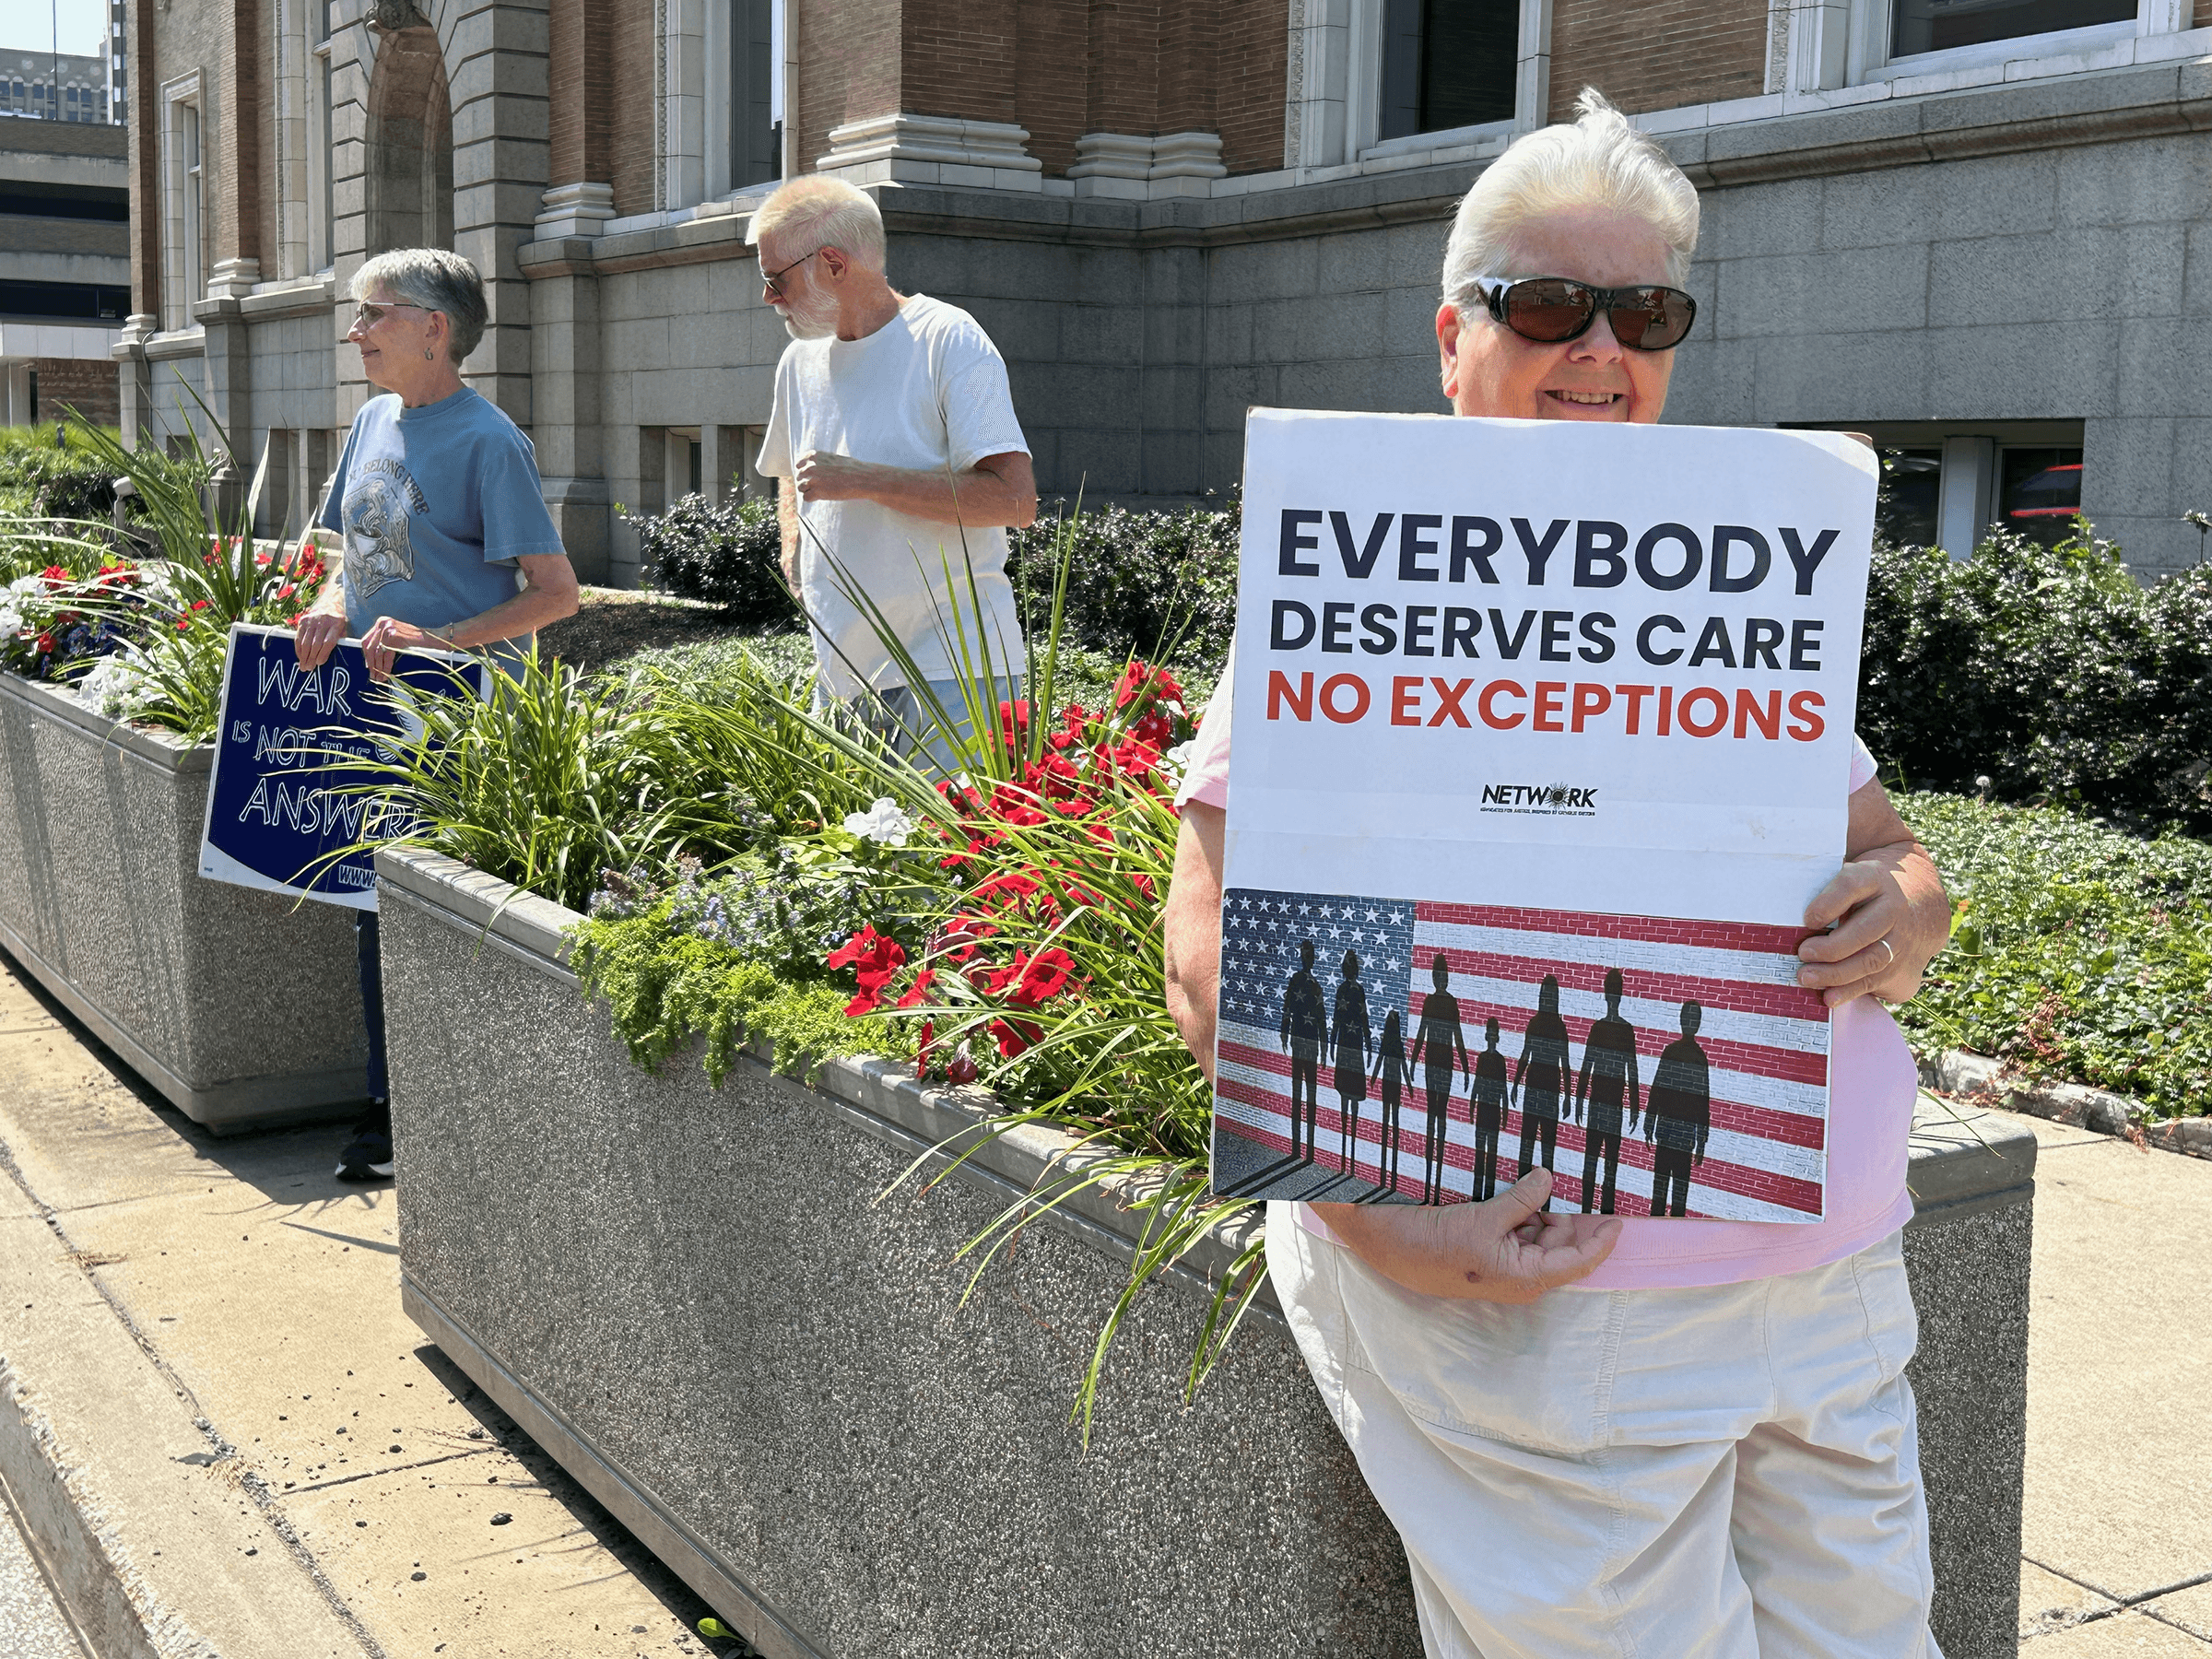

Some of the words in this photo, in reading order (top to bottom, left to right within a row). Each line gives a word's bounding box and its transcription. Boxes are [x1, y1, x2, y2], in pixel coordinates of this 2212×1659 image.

[364, 458, 407, 480] BELONG
[1278, 508, 1841, 596] EVERYBODY
[1270, 599, 1617, 664] DESERVES
[1636, 614, 1825, 672] CARE
[257, 655, 352, 716] WAR
[1266, 670, 1371, 724] NO
[1390, 676, 1826, 742] EXCEPTIONS
[232, 720, 252, 743] IS
[254, 724, 317, 768] NOT
[1481, 782, 1598, 808] NETWORK
